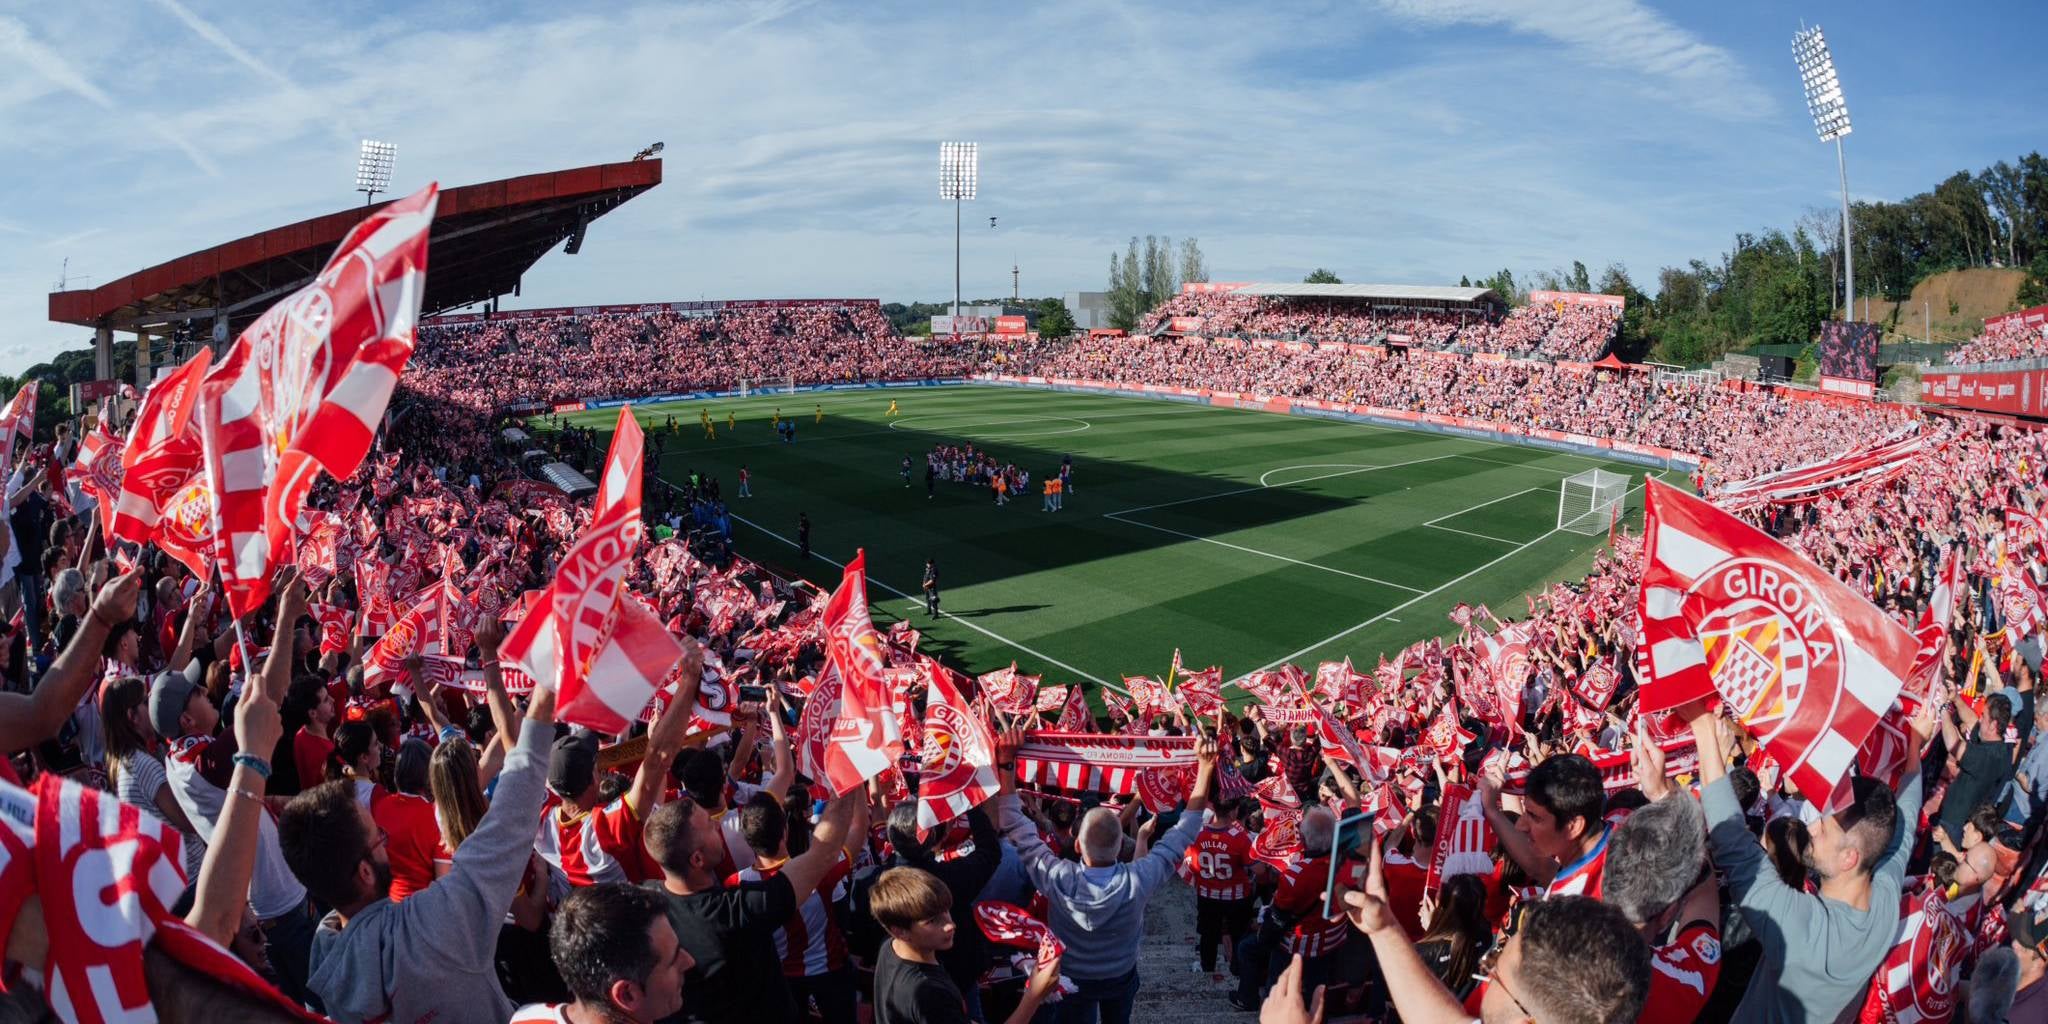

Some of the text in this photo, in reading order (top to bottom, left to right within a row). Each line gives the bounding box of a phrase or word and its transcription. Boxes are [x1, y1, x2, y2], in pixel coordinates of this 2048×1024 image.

[1723, 566, 1833, 668] GIRONA
[835, 718, 857, 731] LUB
[1200, 841, 1228, 851] VILLAR
[1433, 840, 1448, 875] HYLO
[1199, 851, 1233, 880] 95
